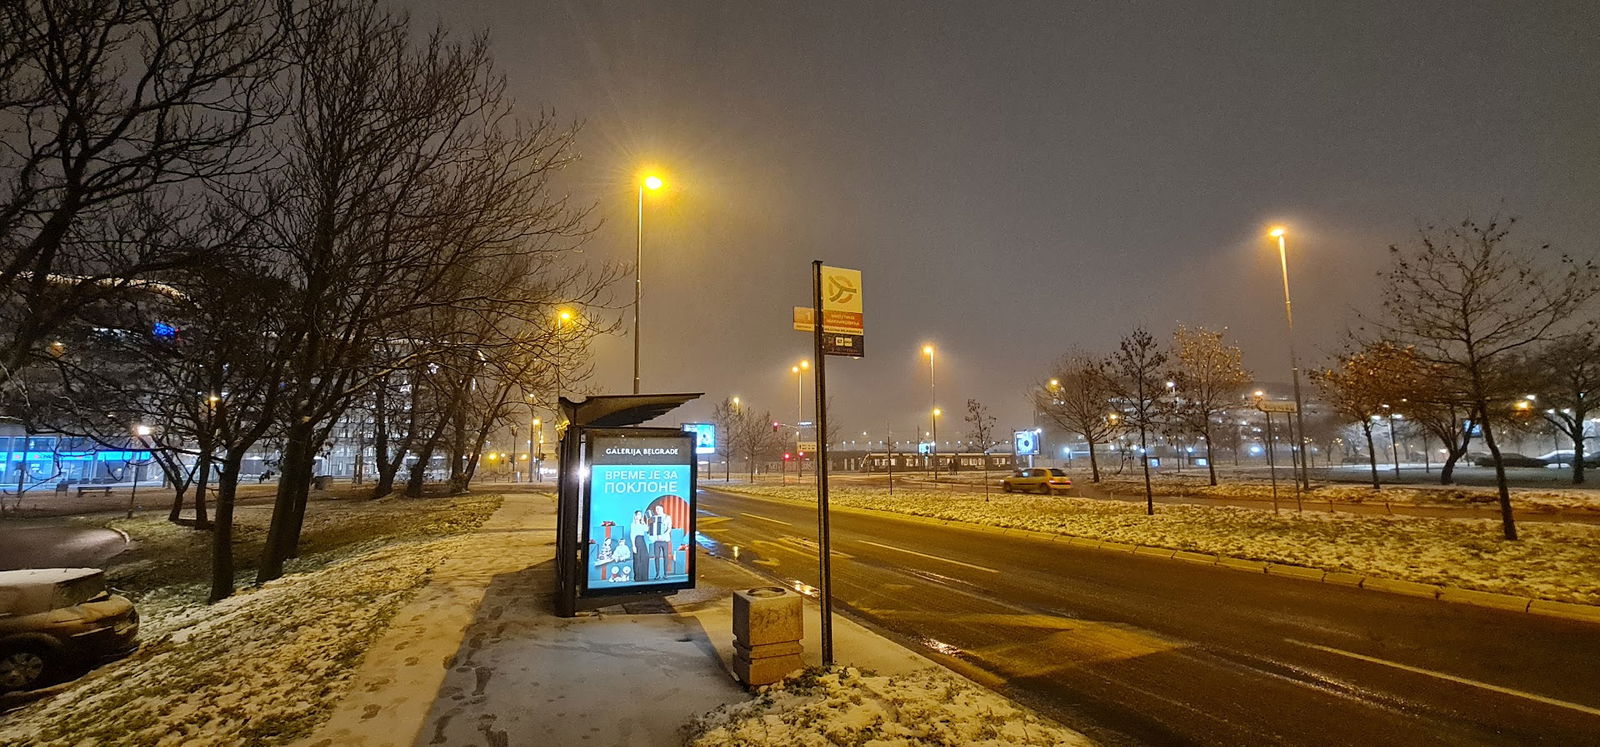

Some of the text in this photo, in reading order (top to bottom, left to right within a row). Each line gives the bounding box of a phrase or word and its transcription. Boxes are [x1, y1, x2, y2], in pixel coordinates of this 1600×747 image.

[605, 470, 678, 480] ВРЕМЕ ЈЕ ЗА
[604, 481, 678, 493] ПОКЛОНЕ
